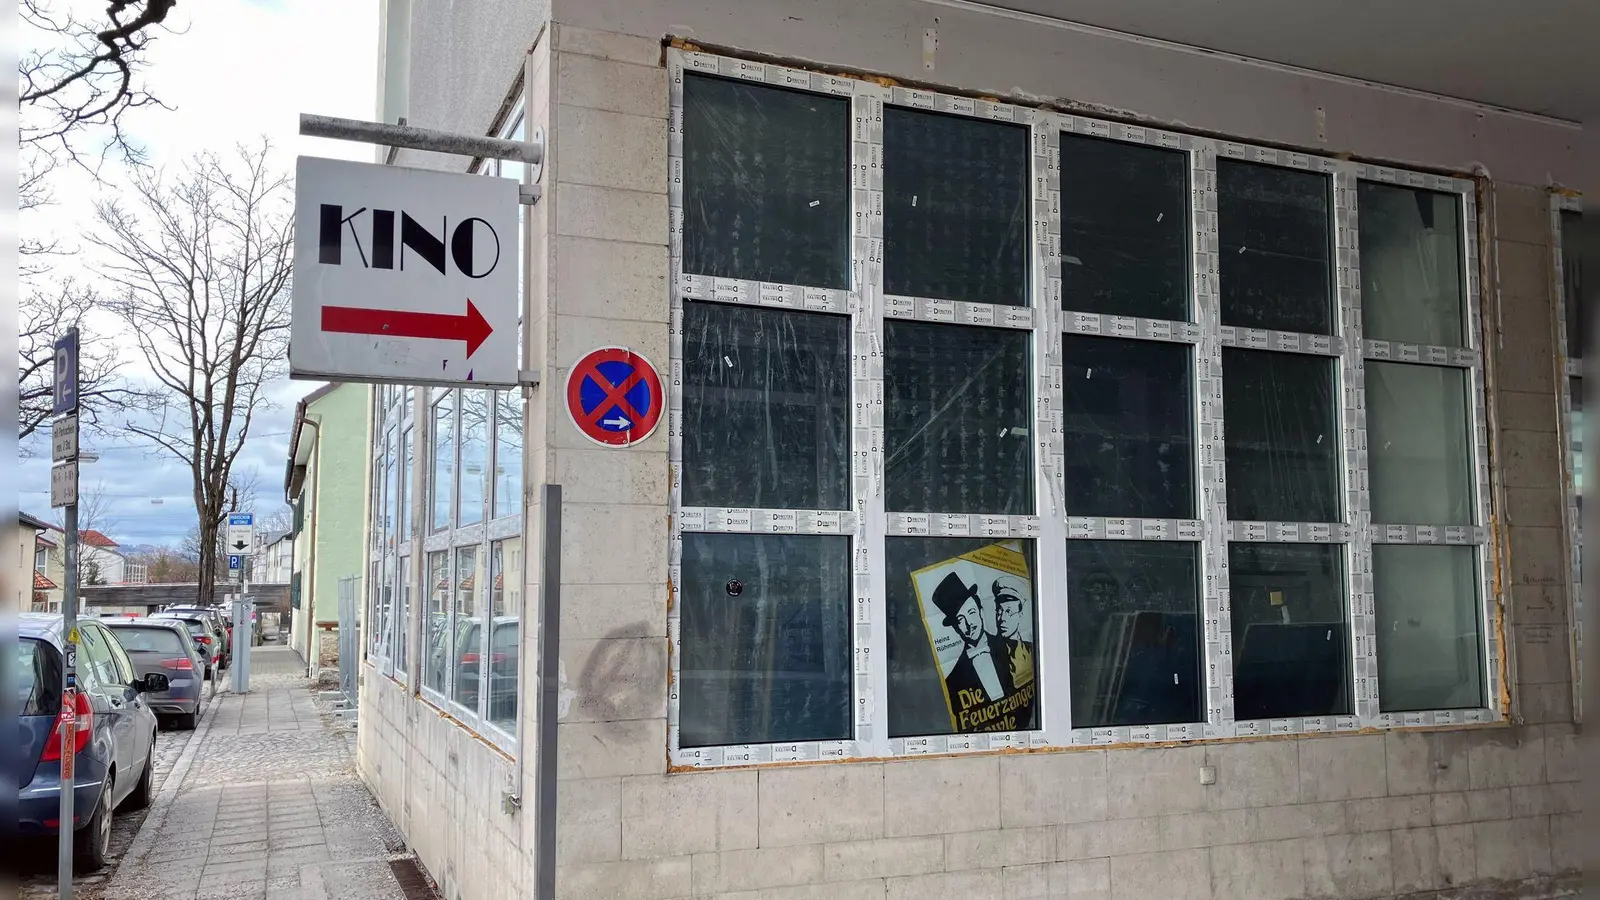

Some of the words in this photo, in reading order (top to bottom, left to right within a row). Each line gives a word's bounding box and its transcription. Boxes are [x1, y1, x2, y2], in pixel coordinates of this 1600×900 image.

[319, 204, 500, 278] KINO
[56, 347, 68, 405] P
[958, 688, 984, 709] Die
